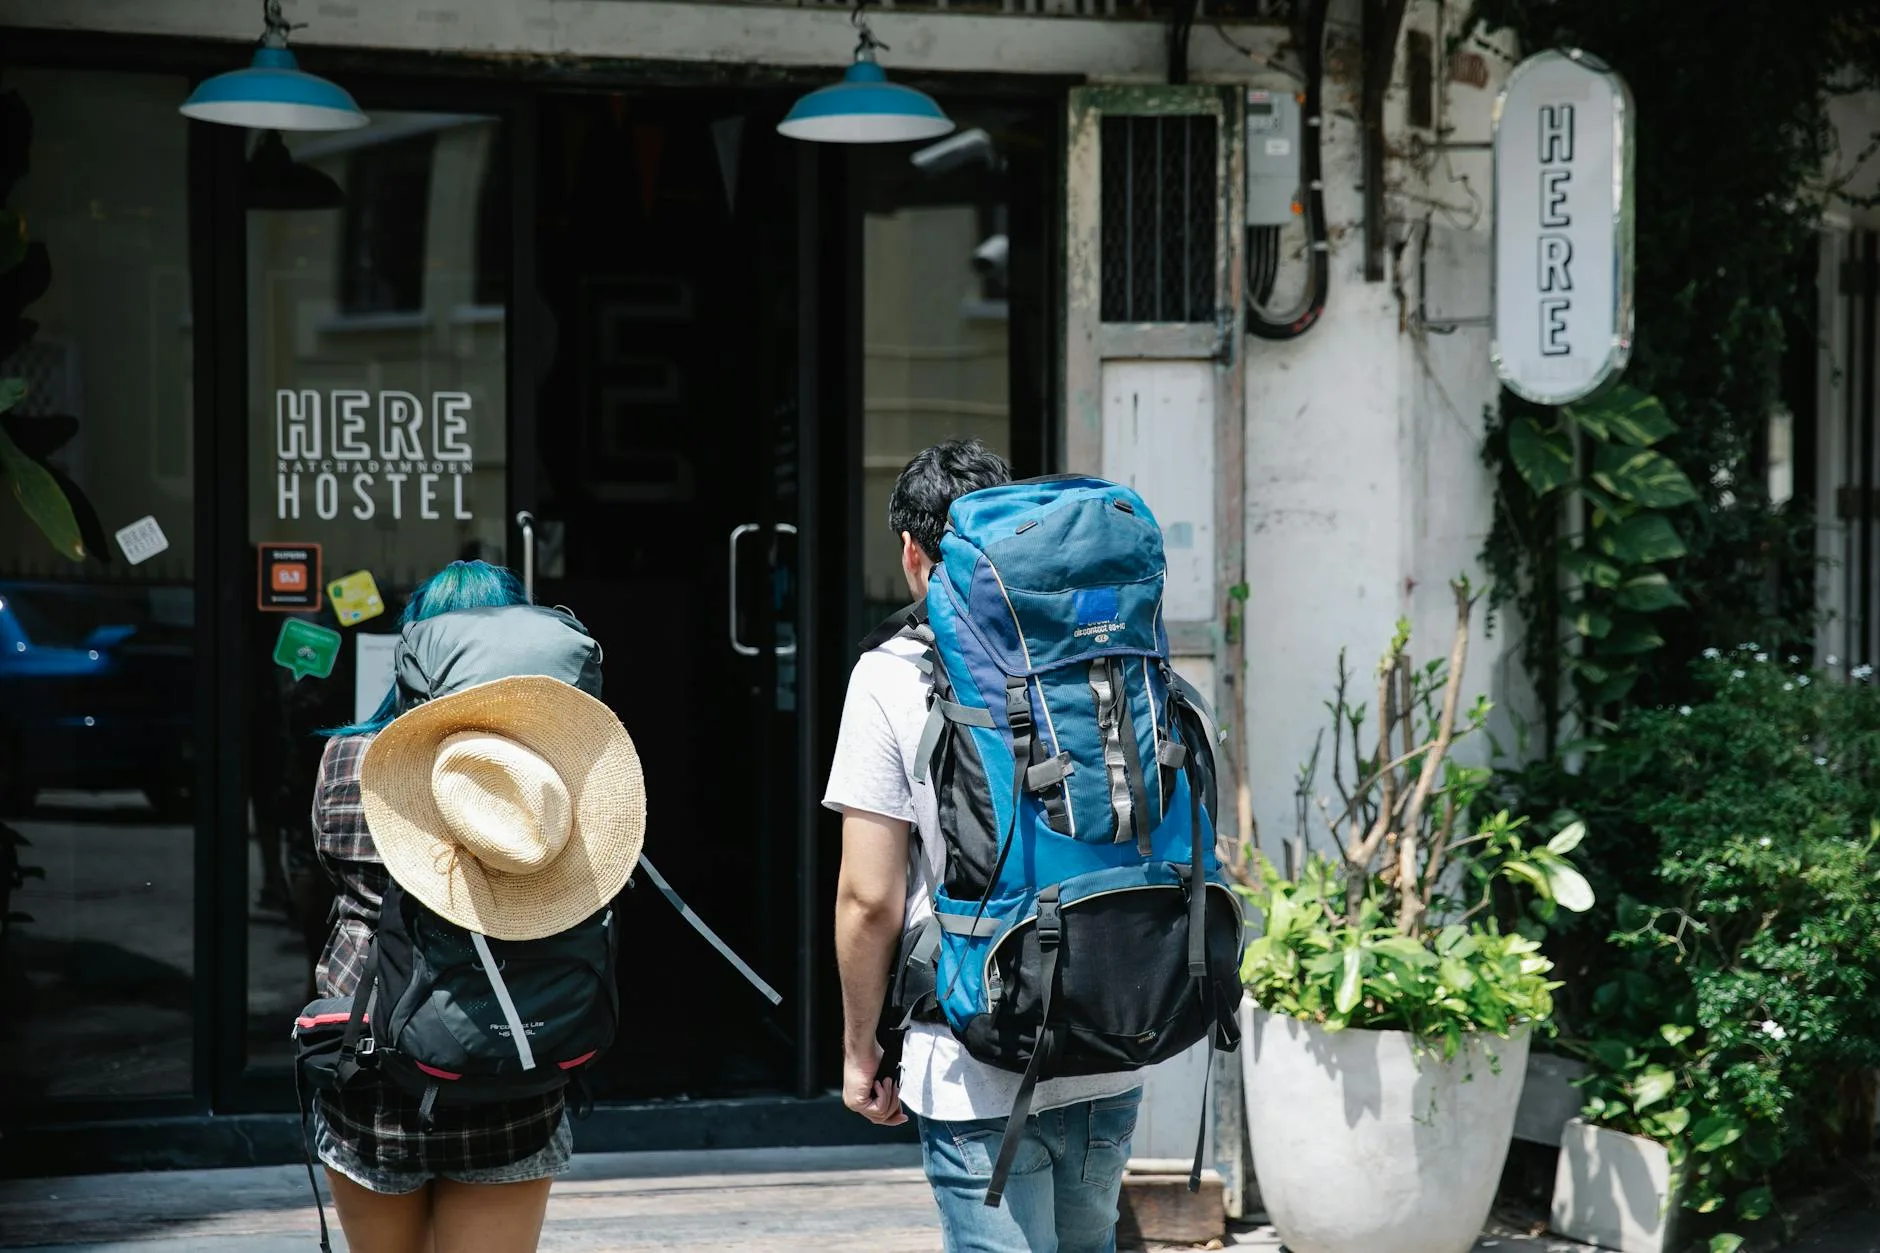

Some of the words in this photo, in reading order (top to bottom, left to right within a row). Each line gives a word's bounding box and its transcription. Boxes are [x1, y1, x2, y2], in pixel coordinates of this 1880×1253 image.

[1538, 104, 1574, 356] HERE
[276, 389, 473, 461] HERE
[277, 460, 474, 474] RATCHADAMNOEN
[277, 472, 474, 520] HOSTEL
